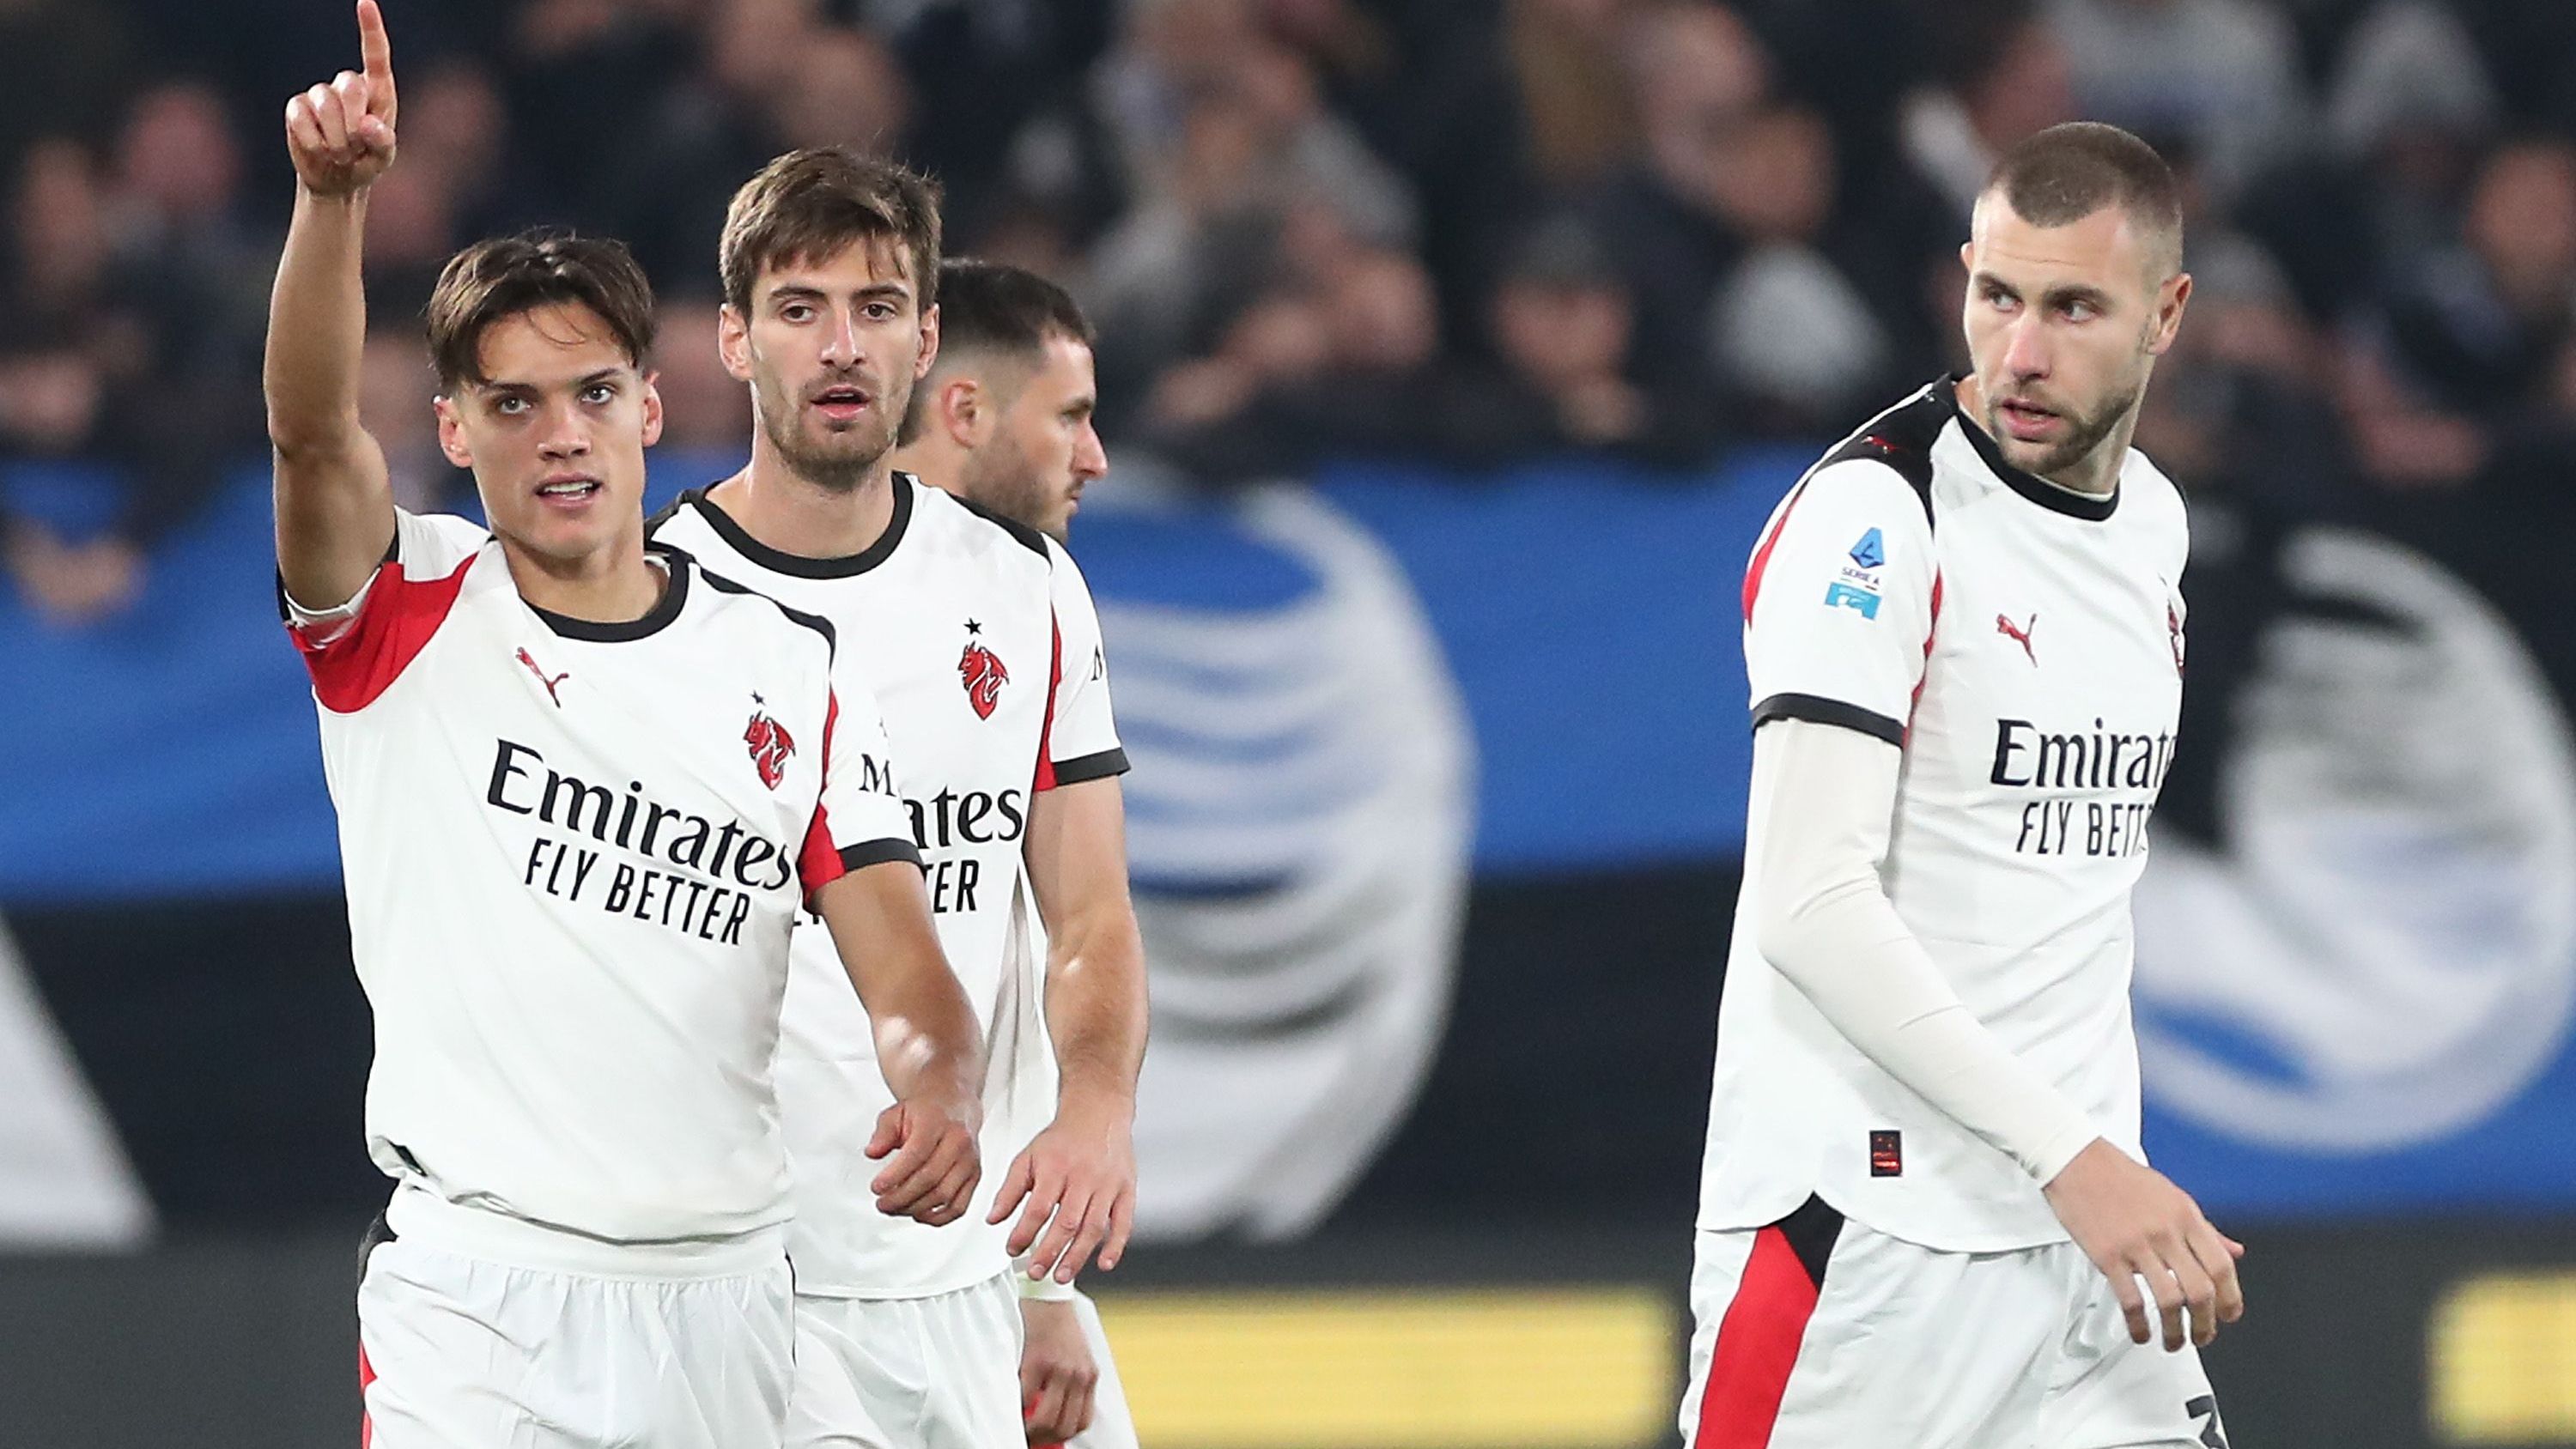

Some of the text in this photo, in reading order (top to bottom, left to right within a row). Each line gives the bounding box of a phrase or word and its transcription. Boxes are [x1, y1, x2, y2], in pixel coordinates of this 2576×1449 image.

[487, 738, 791, 890] Emirates
[902, 785, 1023, 850] ates
[2016, 802, 2072, 854] FLY
[525, 838, 751, 945] FLY BETTER
